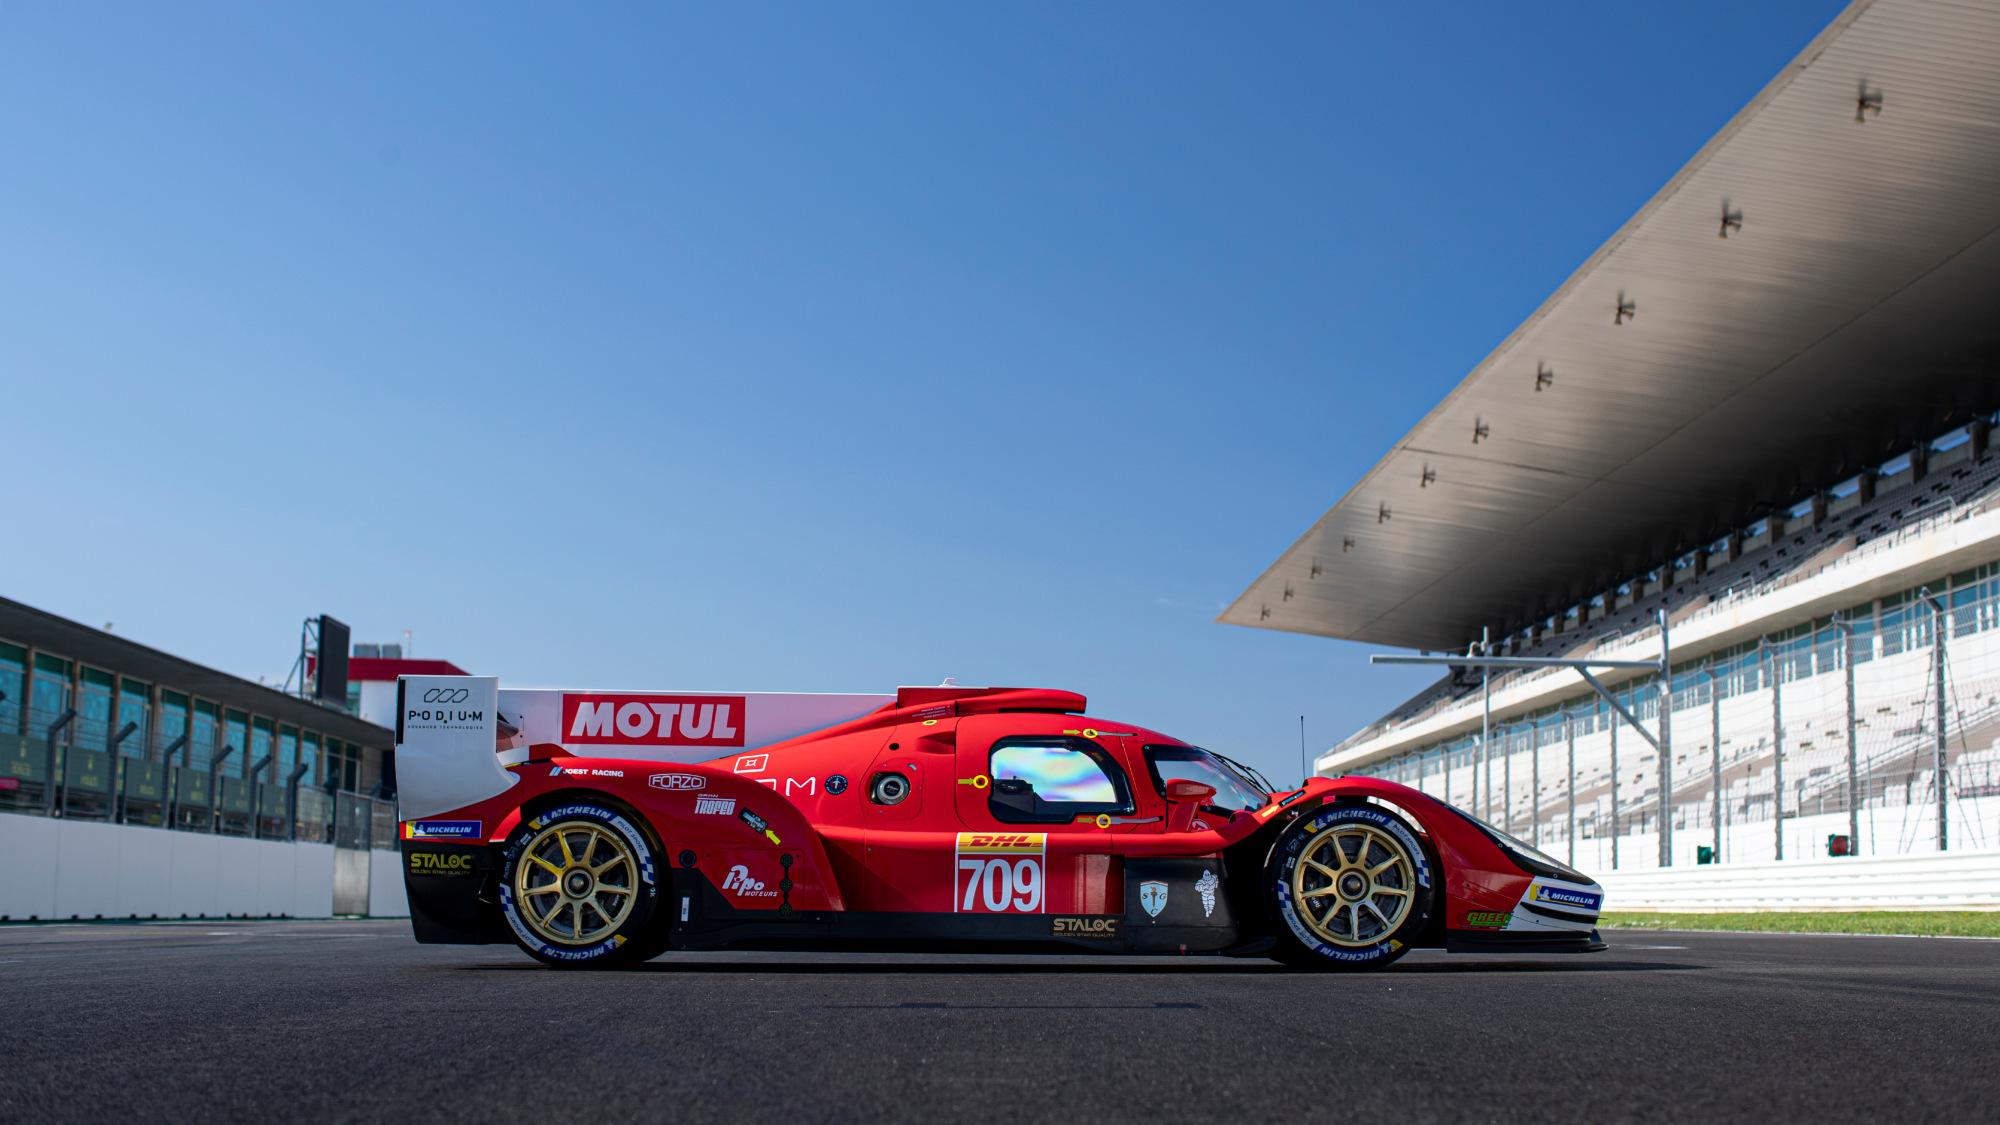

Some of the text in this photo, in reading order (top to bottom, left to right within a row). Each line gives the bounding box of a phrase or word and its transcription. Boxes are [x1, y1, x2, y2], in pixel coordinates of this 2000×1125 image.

[570, 701, 737, 739] MOTUL
[592, 769, 624, 777] RACING
[652, 775, 702, 788] FORZO
[551, 806, 612, 819] MICHELIN
[1327, 809, 1387, 823] MICHELIN
[617, 820, 644, 852] PILOT SPORT
[969, 835, 1032, 847] DHL
[1393, 823, 1420, 856] PILOT SPORT
[410, 853, 471, 869] STALOC
[959, 858, 1042, 912] 709
[1141, 892, 1149, 900] S
[1551, 892, 1595, 905] MICHELIN
[1467, 912, 1514, 923] GREEN
[510, 916, 537, 947] PILOT SPORT
[1053, 918, 1115, 932] STALOC
[544, 946, 605, 960] MICHELIN
[1320, 946, 1380, 961] MICHELIN
